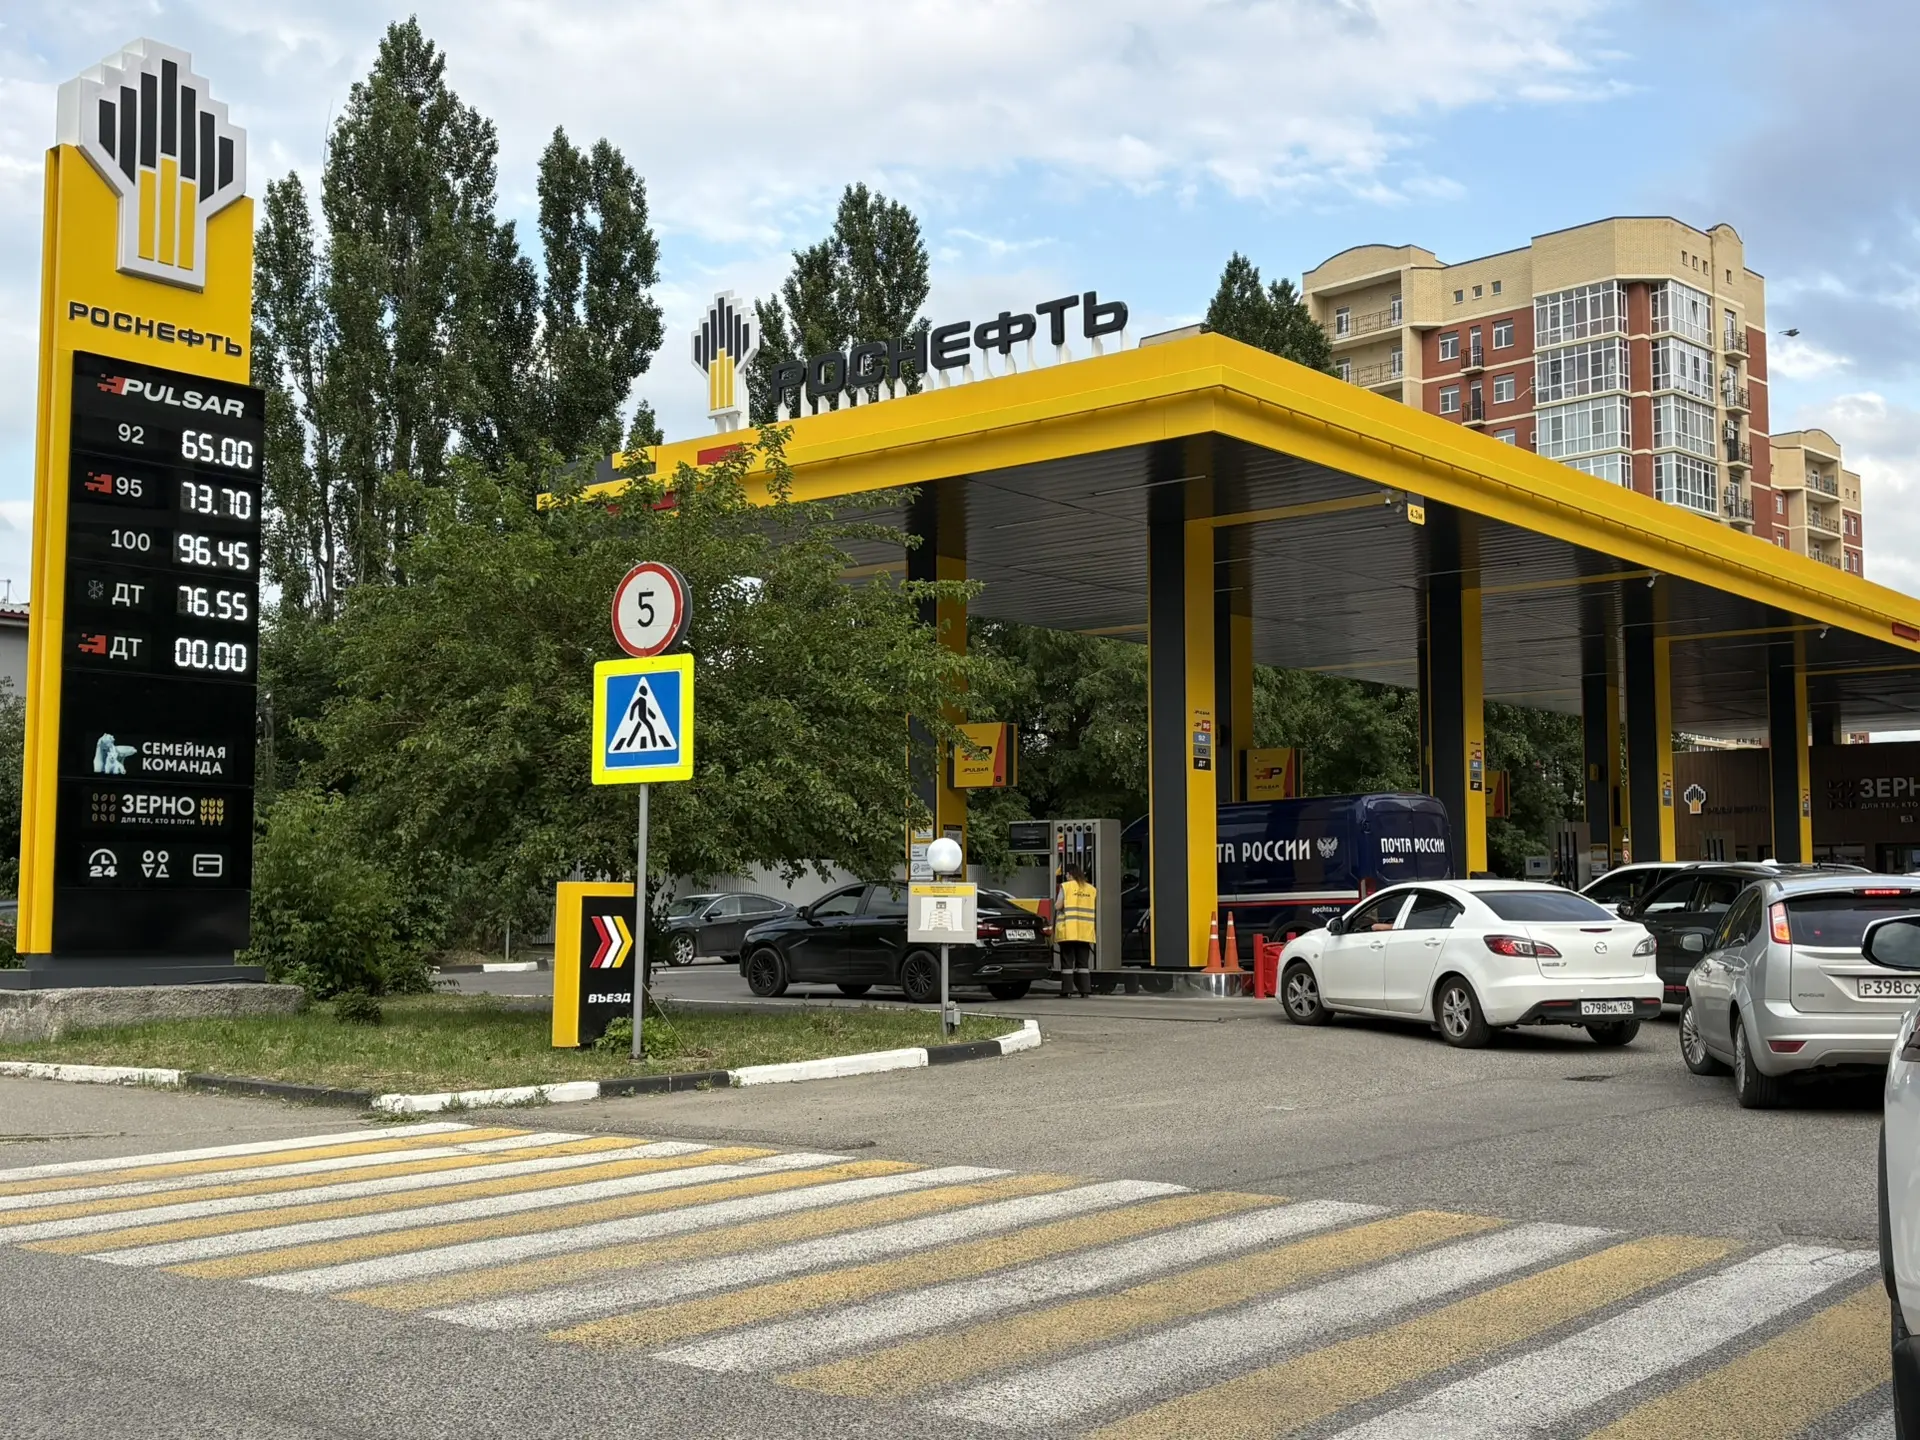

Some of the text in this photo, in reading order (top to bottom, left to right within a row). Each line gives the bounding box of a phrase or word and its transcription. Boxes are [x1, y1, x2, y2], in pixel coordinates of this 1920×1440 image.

[68, 301, 243, 357] РОСНЕФТЬ
[771, 290, 1129, 405] РОСНЕФТЬ
[121, 378, 245, 418] PULSAR
[118, 423, 253, 470] 92 65.00
[116, 476, 251, 520] 95 73.70
[111, 529, 250, 571] 100 96.45
[111, 582, 248, 622] ДТ 76.55
[637, 591, 655, 628] 5
[109, 636, 247, 673] ДТ 00.00
[141, 741, 226, 759] СЕМЕЙНАЯ
[141, 757, 223, 776] КОМАНДА
[1860, 777, 1920, 799] ЗЕРН
[121, 793, 196, 816] ЗЕРНО
[120, 816, 136, 824] ДЛЯ
[1242, 838, 1311, 863] РОССИИ
[1381, 838, 1446, 853] ПОЧТА РОССИИ
[89, 865, 118, 878] 24
[1312, 905, 1341, 915] pochta.ru
[587, 992, 631, 1004] ВЪЕЗД
[1620, 1001, 1632, 1010] 126
